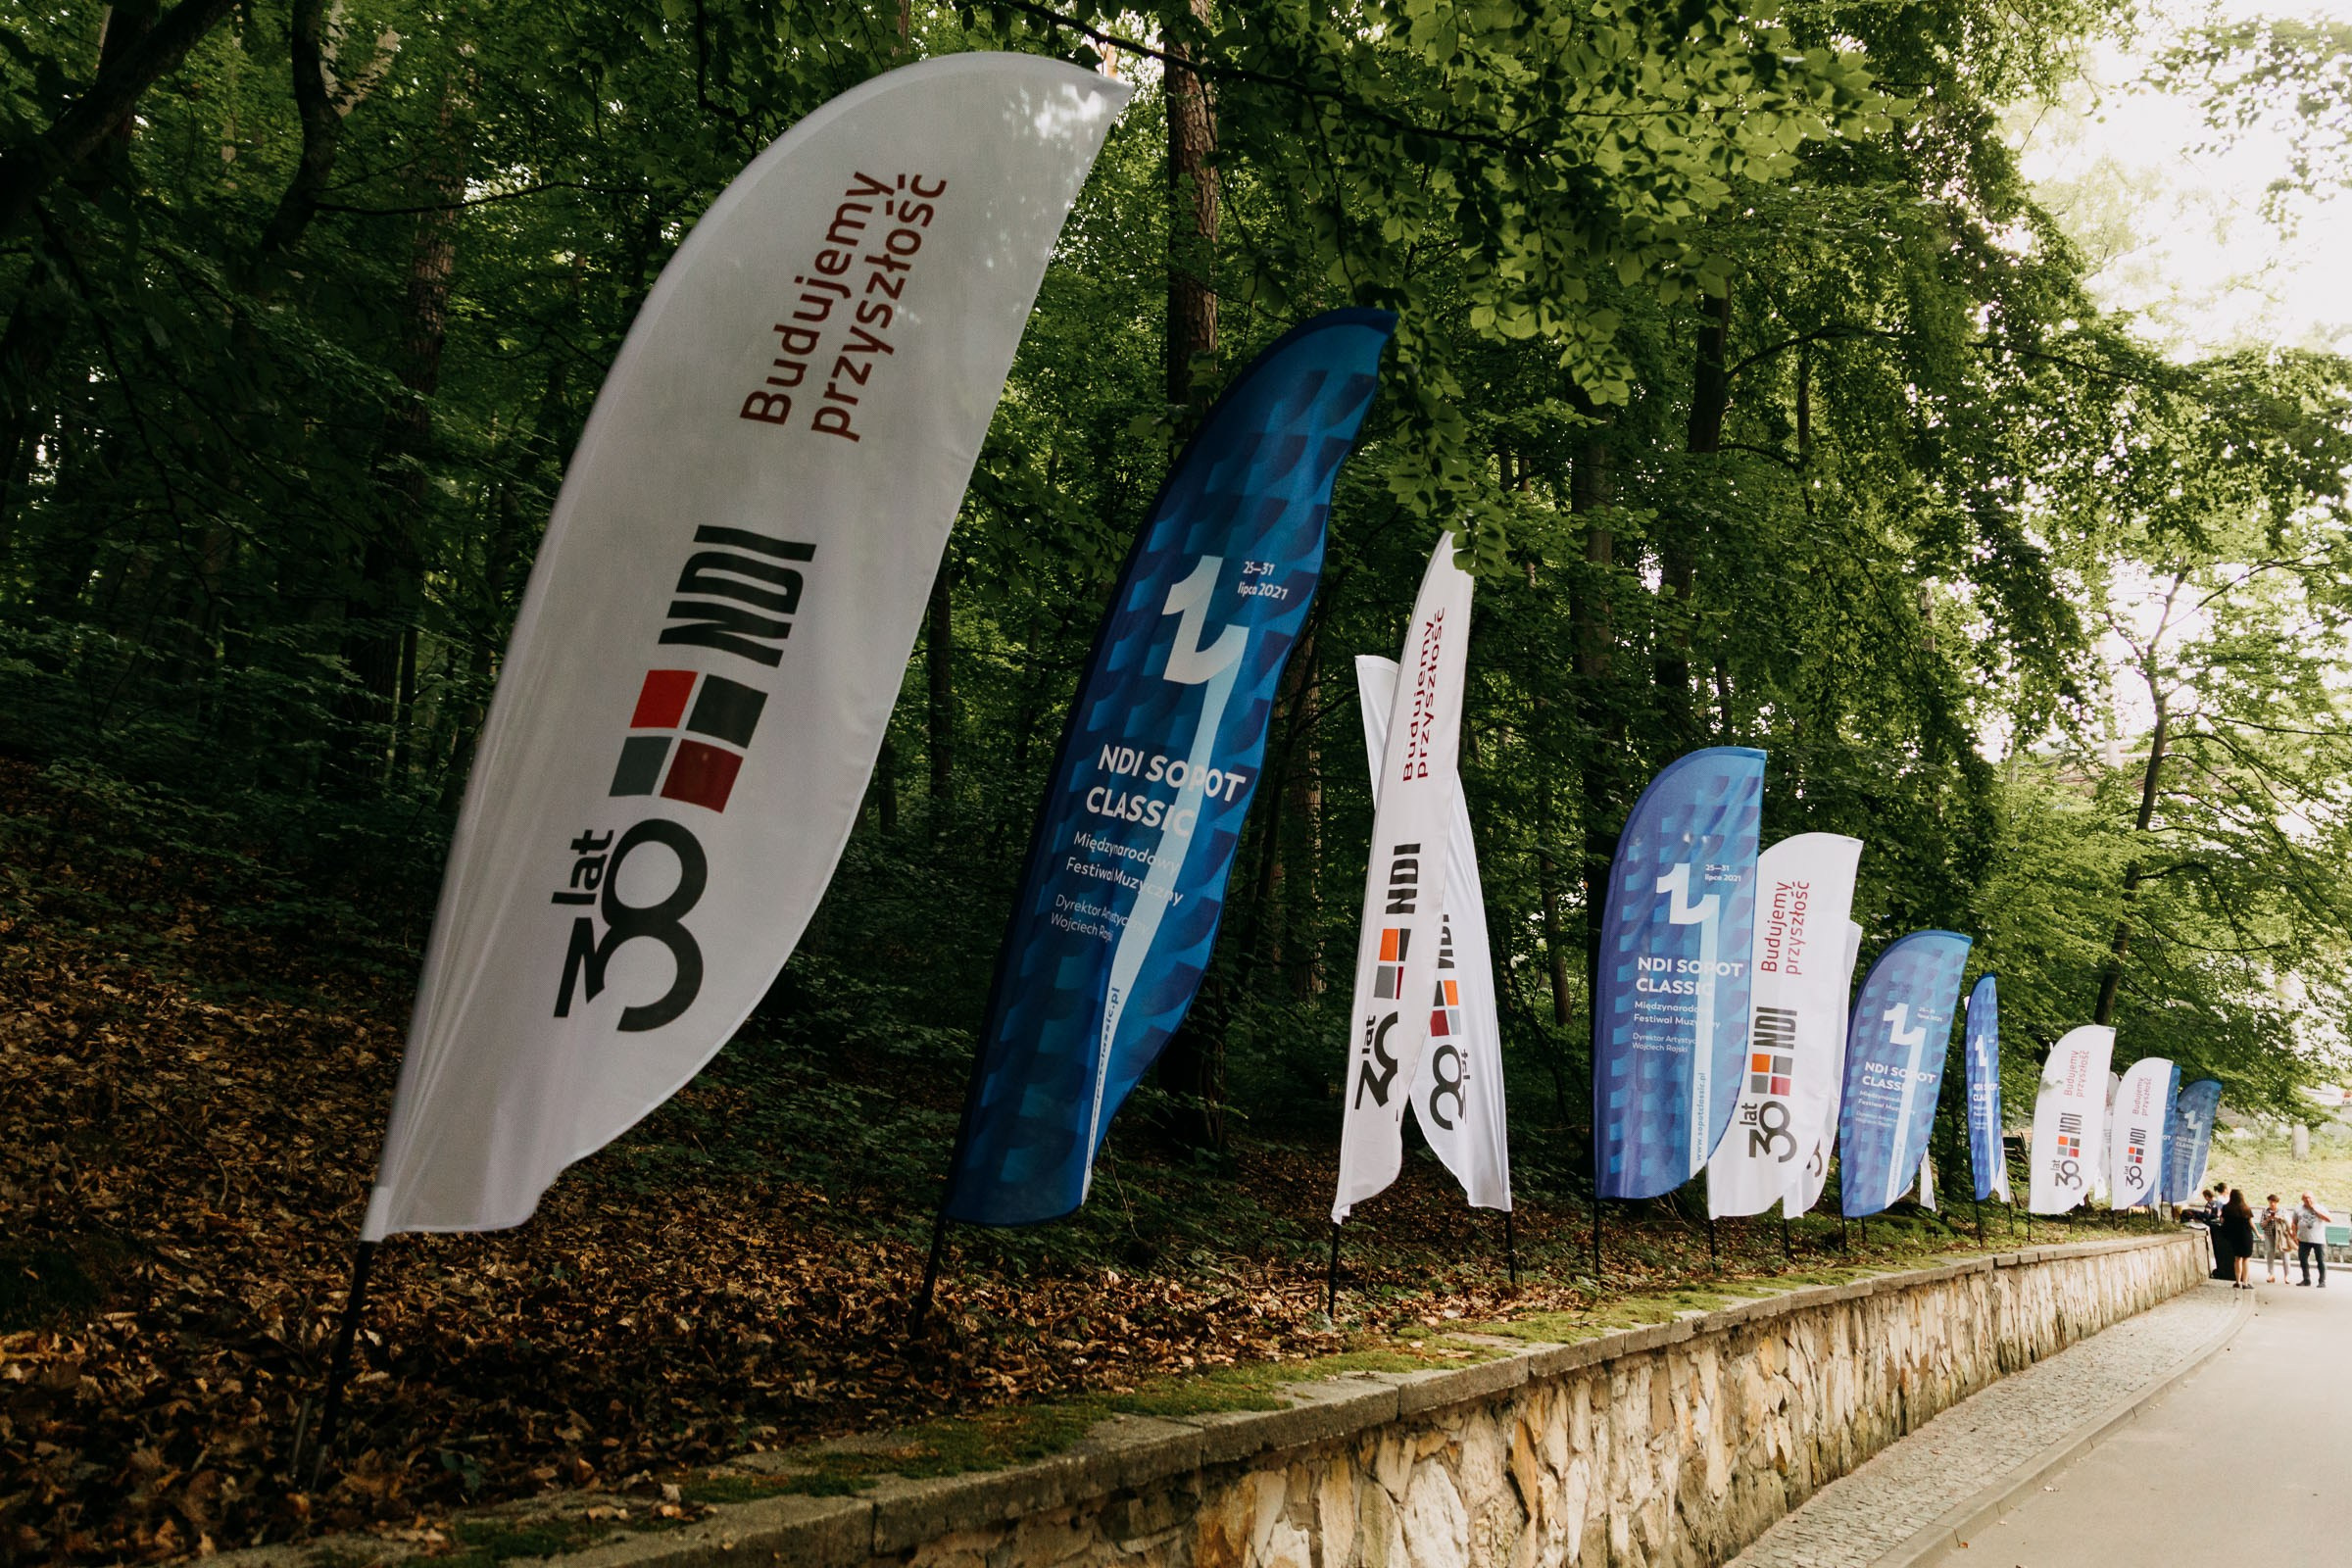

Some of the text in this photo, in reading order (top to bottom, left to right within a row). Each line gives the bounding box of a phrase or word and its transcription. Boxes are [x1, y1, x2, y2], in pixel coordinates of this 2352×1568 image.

[739, 172, 895, 425] Budujemy
[810, 173, 947, 442] przyszłość
[658, 524, 817, 667] NDI
[1237, 581, 1289, 600] lipca 2021
[1402, 620, 1435, 782] Budujemy
[1417, 607, 1446, 779] przyszłość
[1098, 744, 1247, 803] NDI SOPOT
[1086, 786, 1199, 838] CLASSIC
[551, 829, 614, 906] lat
[1065, 856, 1115, 883] Festiwal
[1385, 843, 1421, 914] NDI
[1054, 894, 1102, 917] Dyrektor
[553, 818, 708, 1033] 30
[1051, 912, 1099, 937] Wojciech
[1760, 881, 1792, 973] Budujemy
[1786, 880, 1810, 975] przyszłość
[1638, 956, 1743, 977] NDI SOPOT
[1636, 977, 1714, 996] CLASSIC
[1634, 1001, 1703, 1013] Międzynarodo
[1634, 1013, 1721, 1030] Festiwal Muzyy
[1361, 1014, 1376, 1054] lat
[1665, 1035, 1698, 1045] Artystyc
[1753, 1005, 1797, 1050] NDI
[1862, 1075, 1909, 1093] CLASS
[1865, 1061, 1936, 1084] NDI SOOT
[2064, 1051, 2079, 1096] Budujemy
[1740, 1102, 1757, 1126] lat
[2059, 1112, 2082, 1135] NDI
[1748, 1101, 1797, 1163] 30
[2129, 1127, 2147, 1146] NDI
[2050, 1159, 2060, 1171] lat
[2054, 1159, 2082, 1191] 30
[2126, 1165, 2144, 1190] 30
